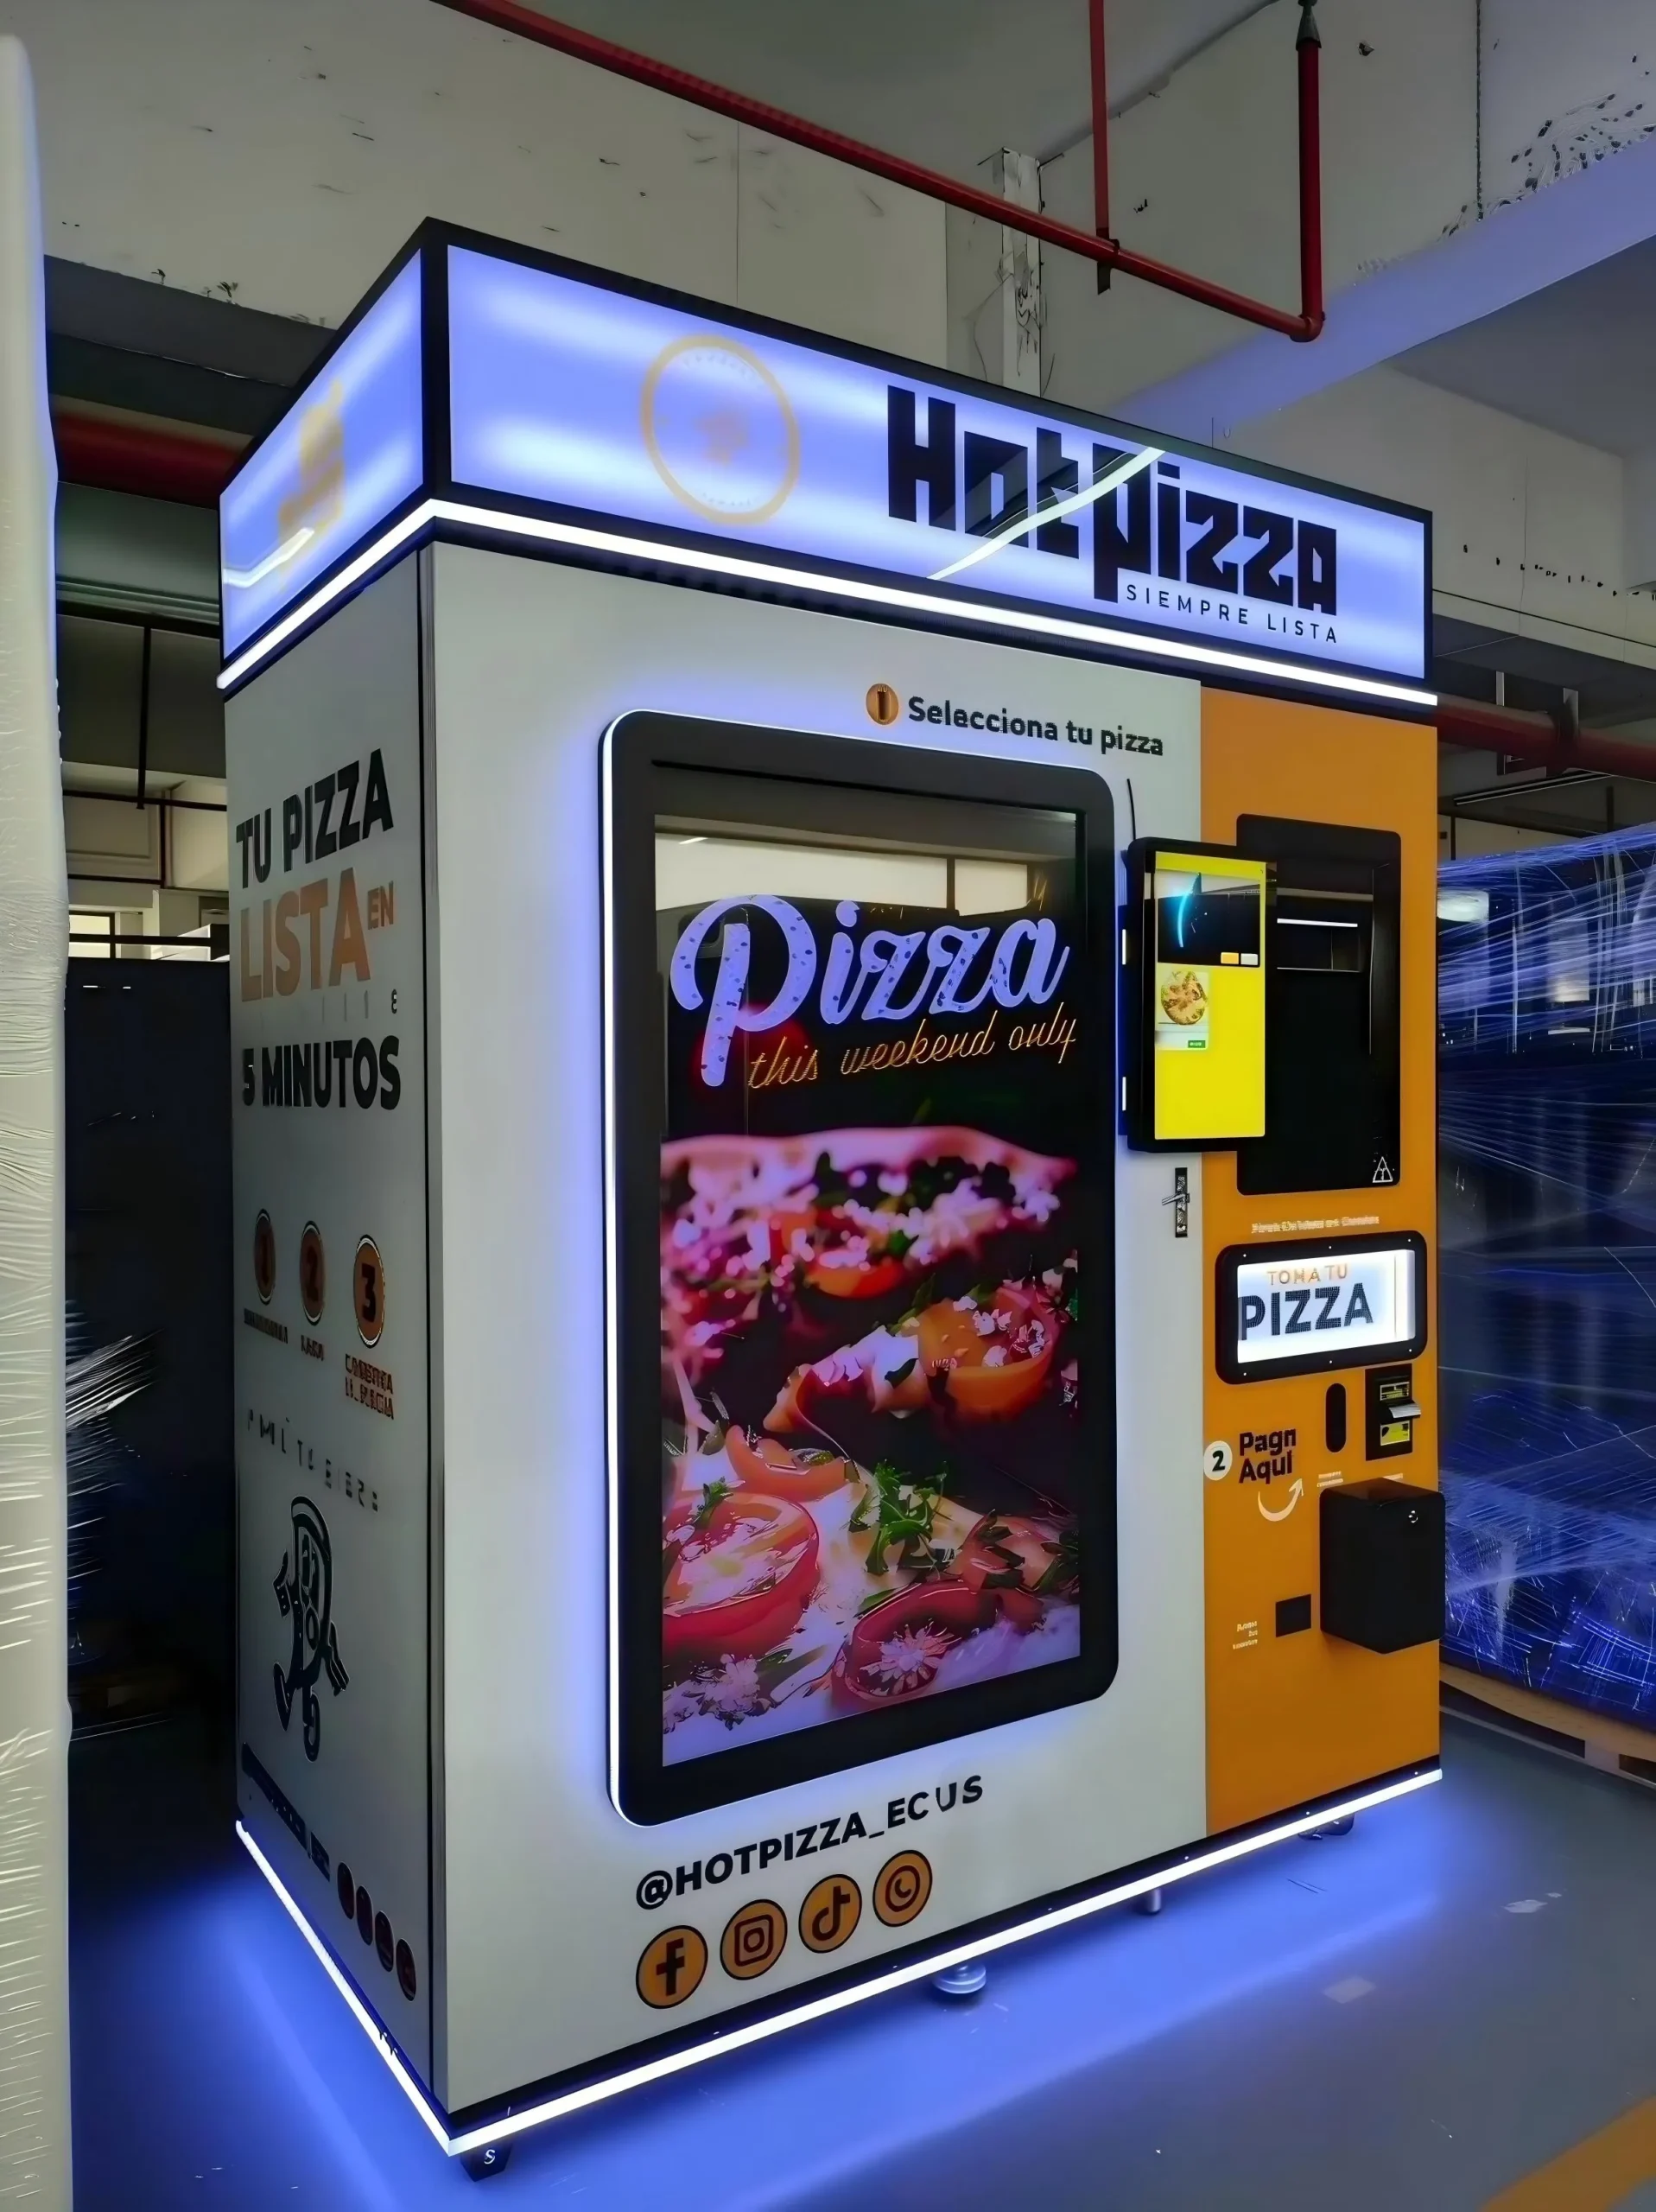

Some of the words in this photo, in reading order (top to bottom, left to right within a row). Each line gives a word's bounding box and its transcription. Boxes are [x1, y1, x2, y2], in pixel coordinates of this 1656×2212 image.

[1126, 584, 1248, 625] SIEMPRE
[1267, 613, 1336, 643] LISTA
[1065, 720, 1092, 745] tu
[1101, 725, 1163, 755] pizza
[236, 807, 272, 889] TU
[283, 748, 394, 873] PIZZA
[240, 867, 371, 1002] LISTA
[367, 880, 395, 931] EN
[670, 894, 1070, 1087] Pizza
[262, 1035, 401, 1110] MINUTOS
[748, 1037, 819, 1089] this
[841, 1010, 994, 1075] weekend
[1009, 1002, 1076, 1064] only
[1238, 1283, 1374, 1340] PIZZA
[1212, 1450, 1225, 1471] 2
